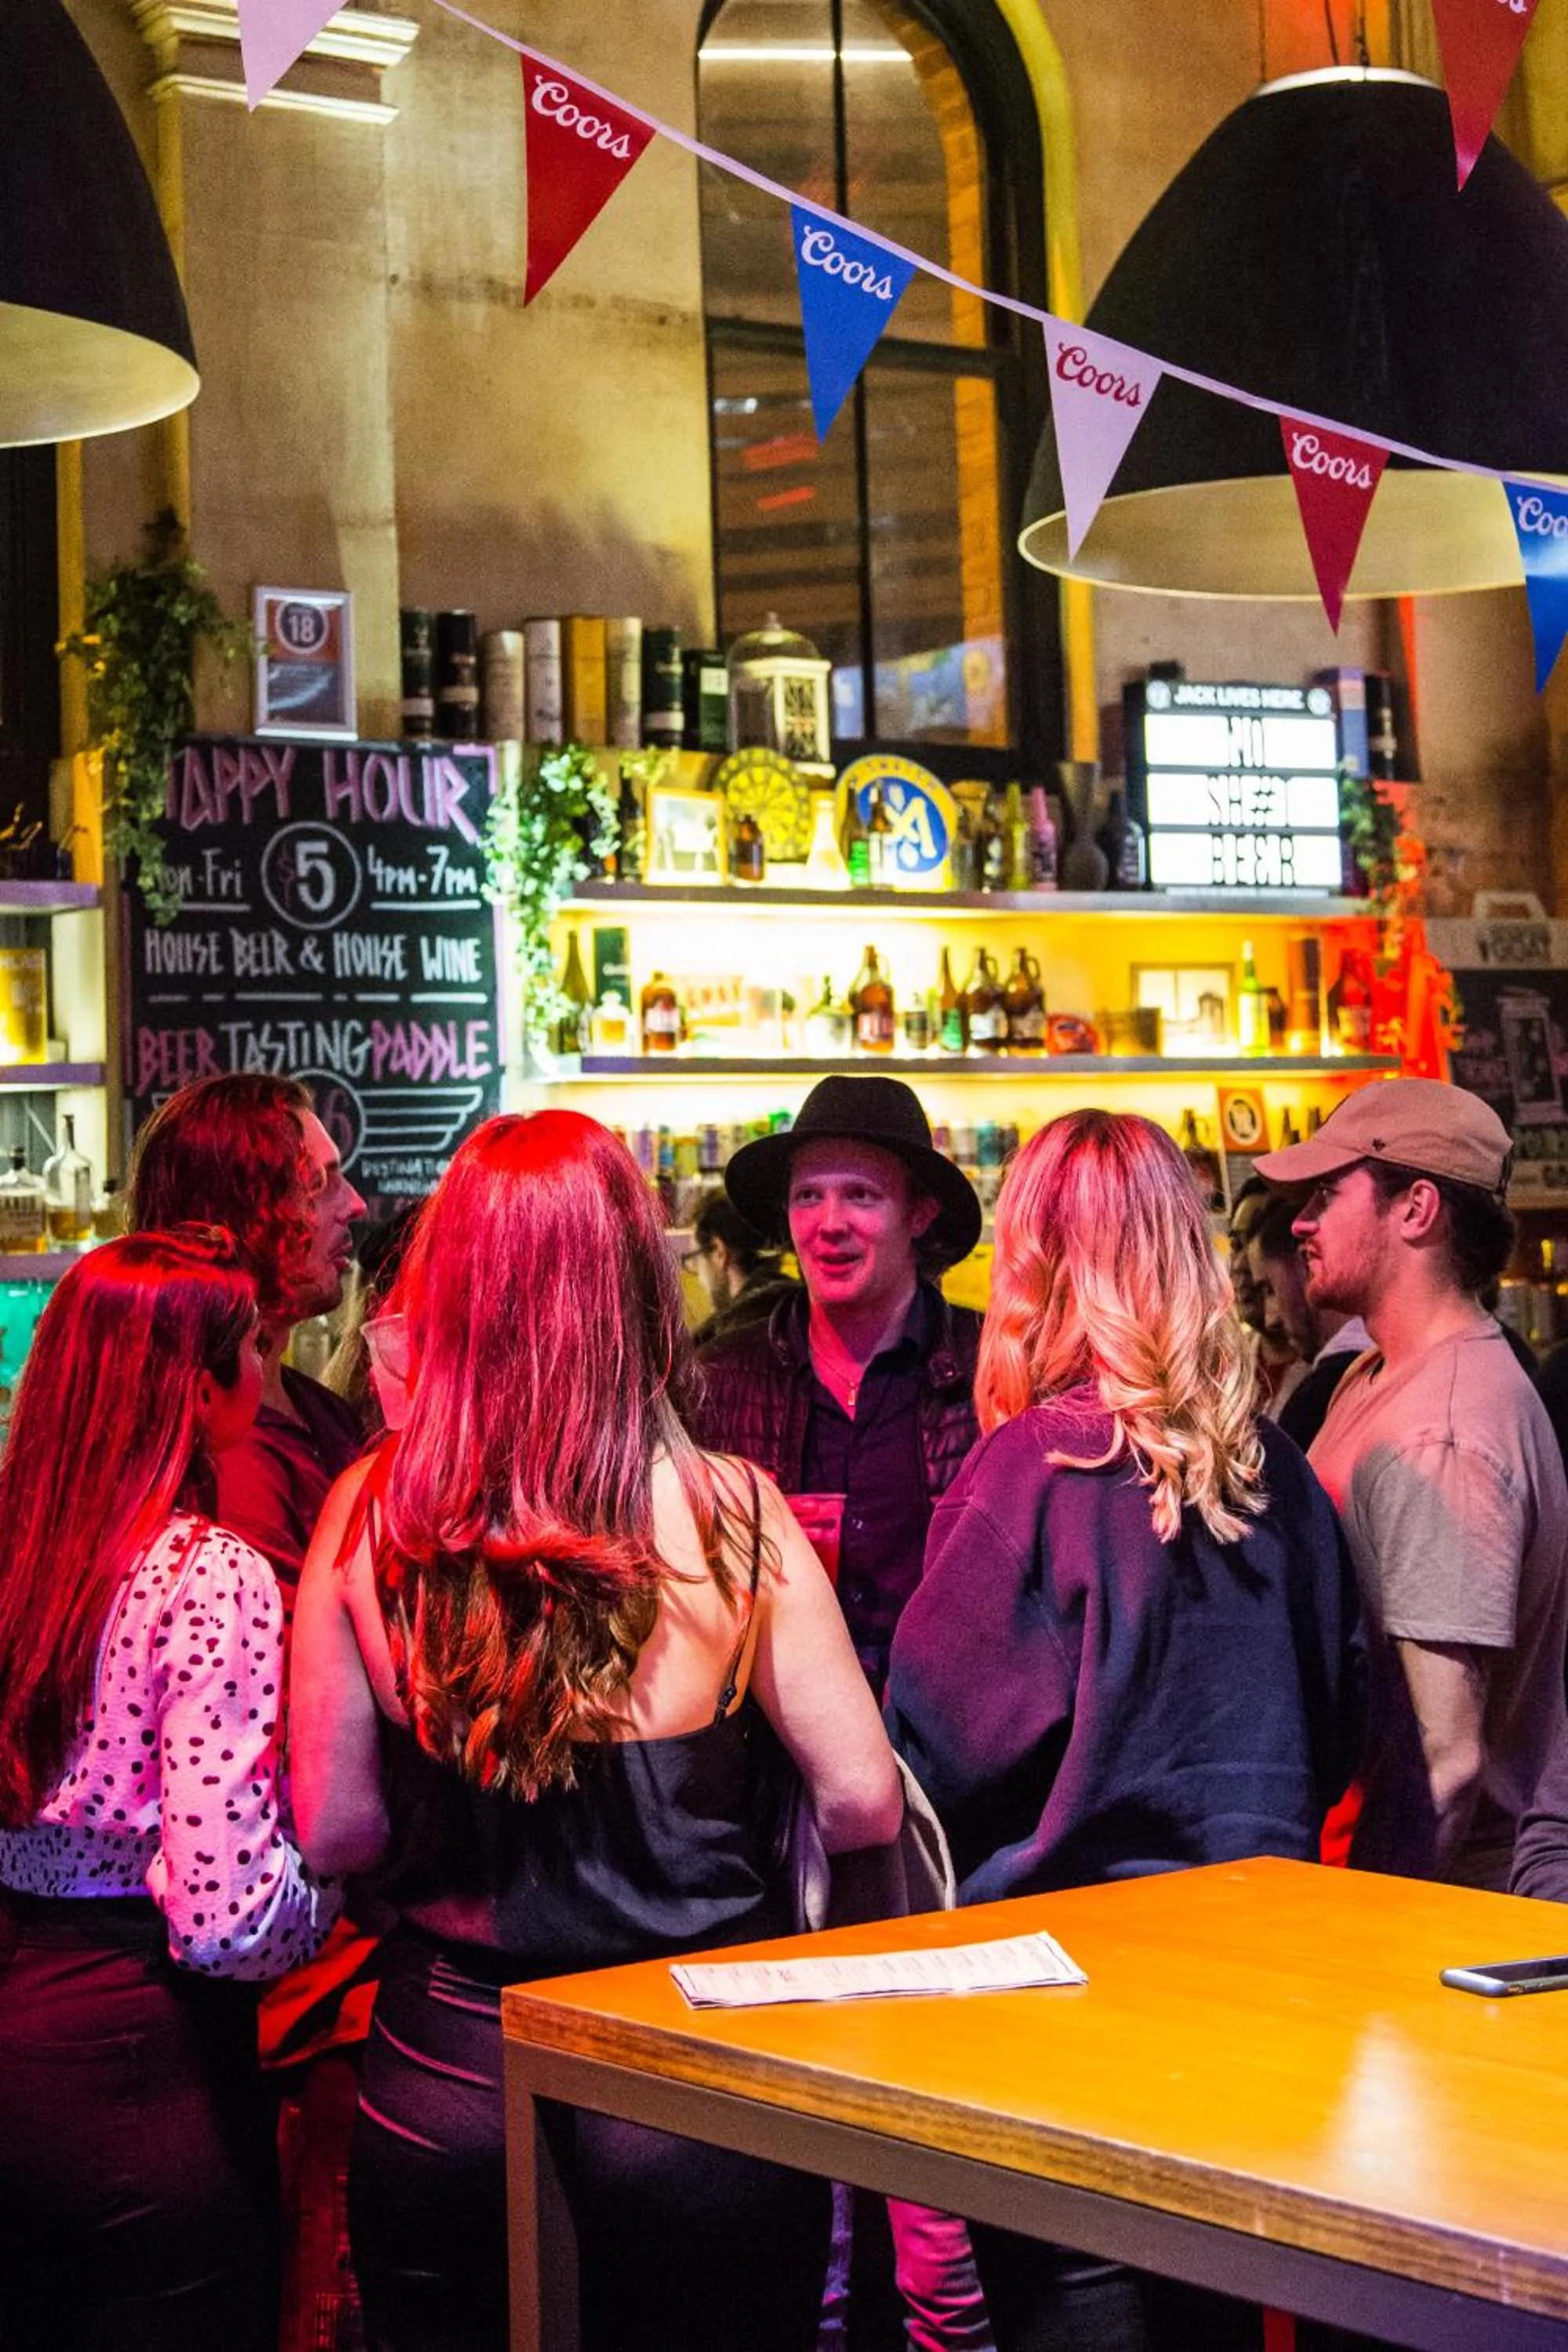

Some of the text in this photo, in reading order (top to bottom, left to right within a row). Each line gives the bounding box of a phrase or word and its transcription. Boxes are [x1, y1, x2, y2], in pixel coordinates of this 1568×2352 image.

[532, 74, 631, 159] Coors
[800, 225, 893, 301] Coors
[1056, 341, 1142, 408] Coors
[1292, 432, 1373, 489] Coors
[288, 615, 315, 642] 18
[322, 749, 480, 846] HOUR
[144, 927, 482, 983] HOUSE BEER & HOUSE WINE
[135, 1019, 492, 1097] BEER TASTING PADDLE
